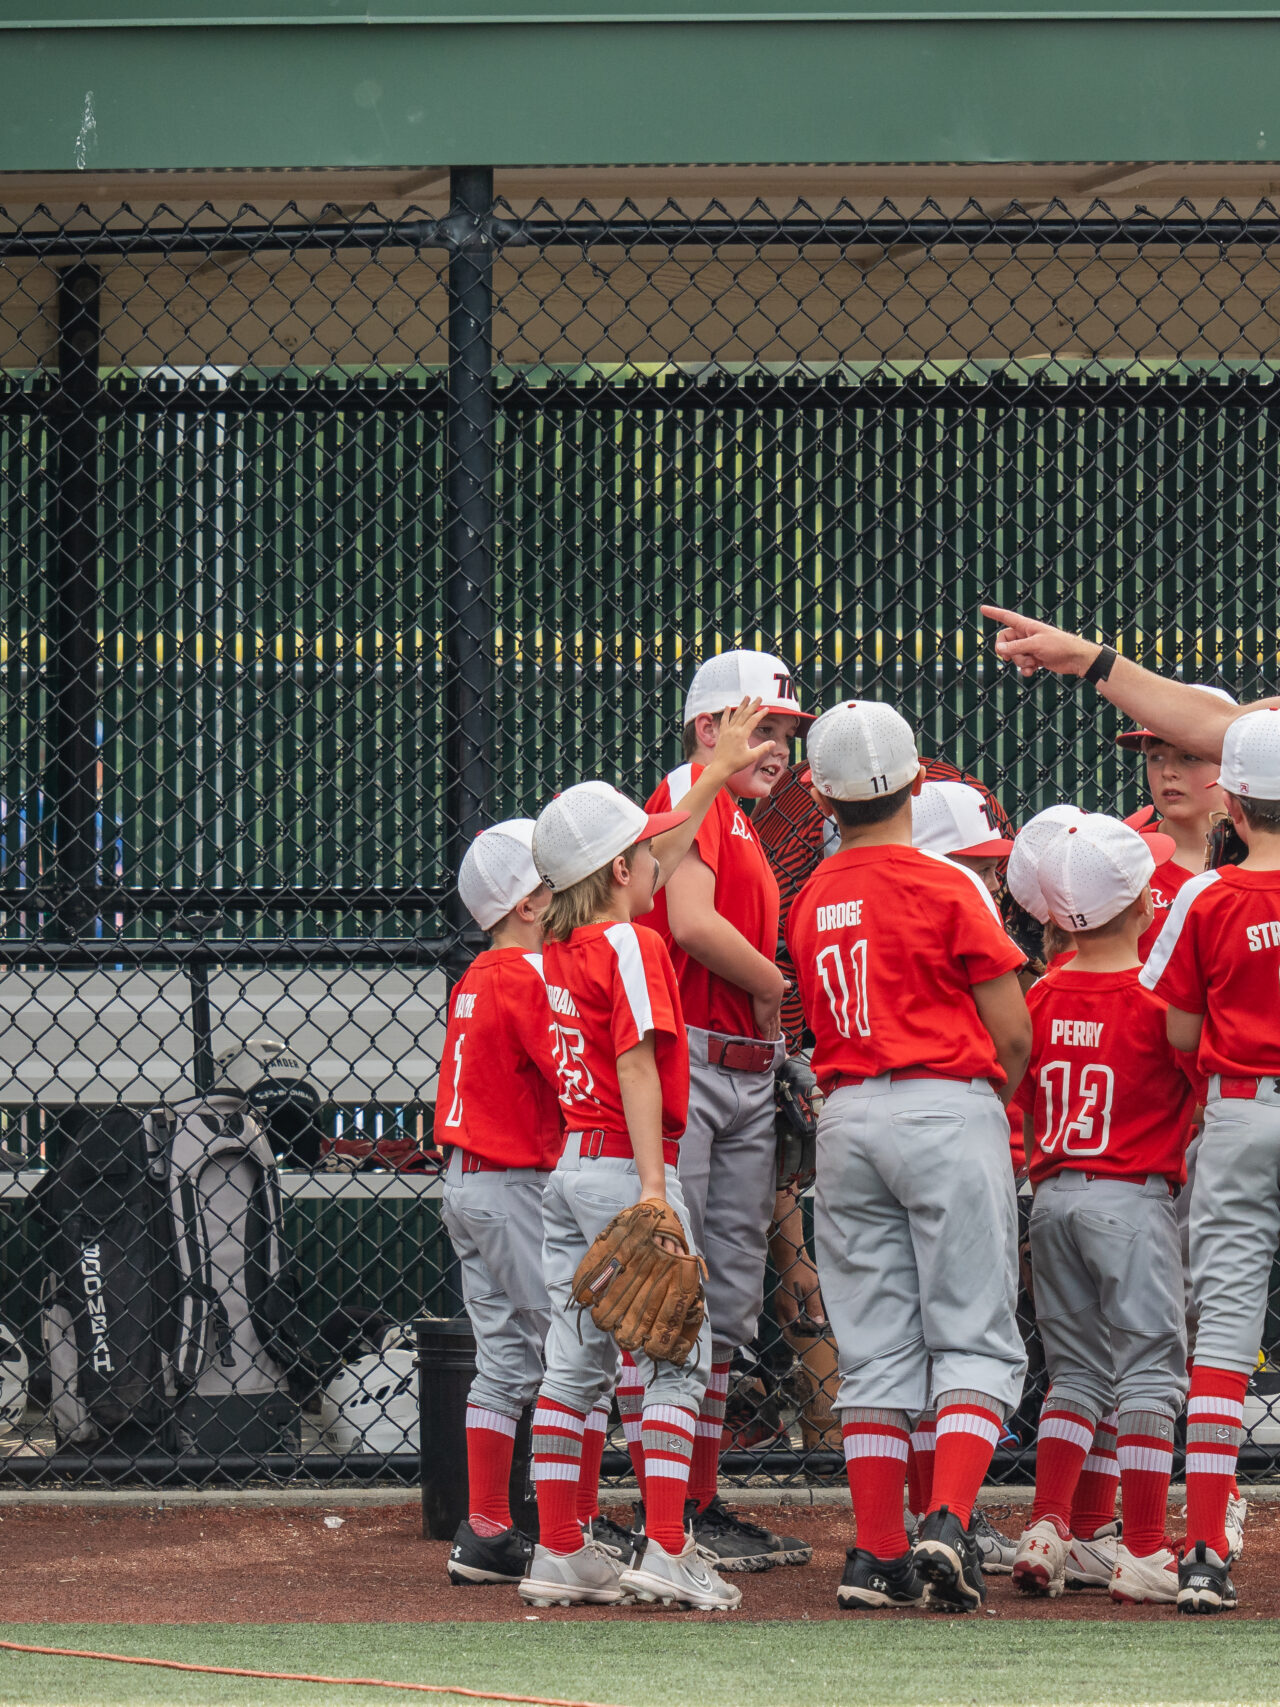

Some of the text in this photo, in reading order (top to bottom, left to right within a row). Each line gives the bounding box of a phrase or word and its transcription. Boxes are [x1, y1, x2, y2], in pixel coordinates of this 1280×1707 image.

[870, 774, 888, 793] 11
[816, 899, 863, 932] DROGE
[1068, 913, 1088, 929] 13
[816, 939, 871, 1039] 11
[1051, 1018, 1104, 1048] PERRY
[1040, 1060, 1115, 1156] 13
[81, 1238, 112, 1373] BOOMBAH
[1187, 1575, 1211, 1588] NIKE
